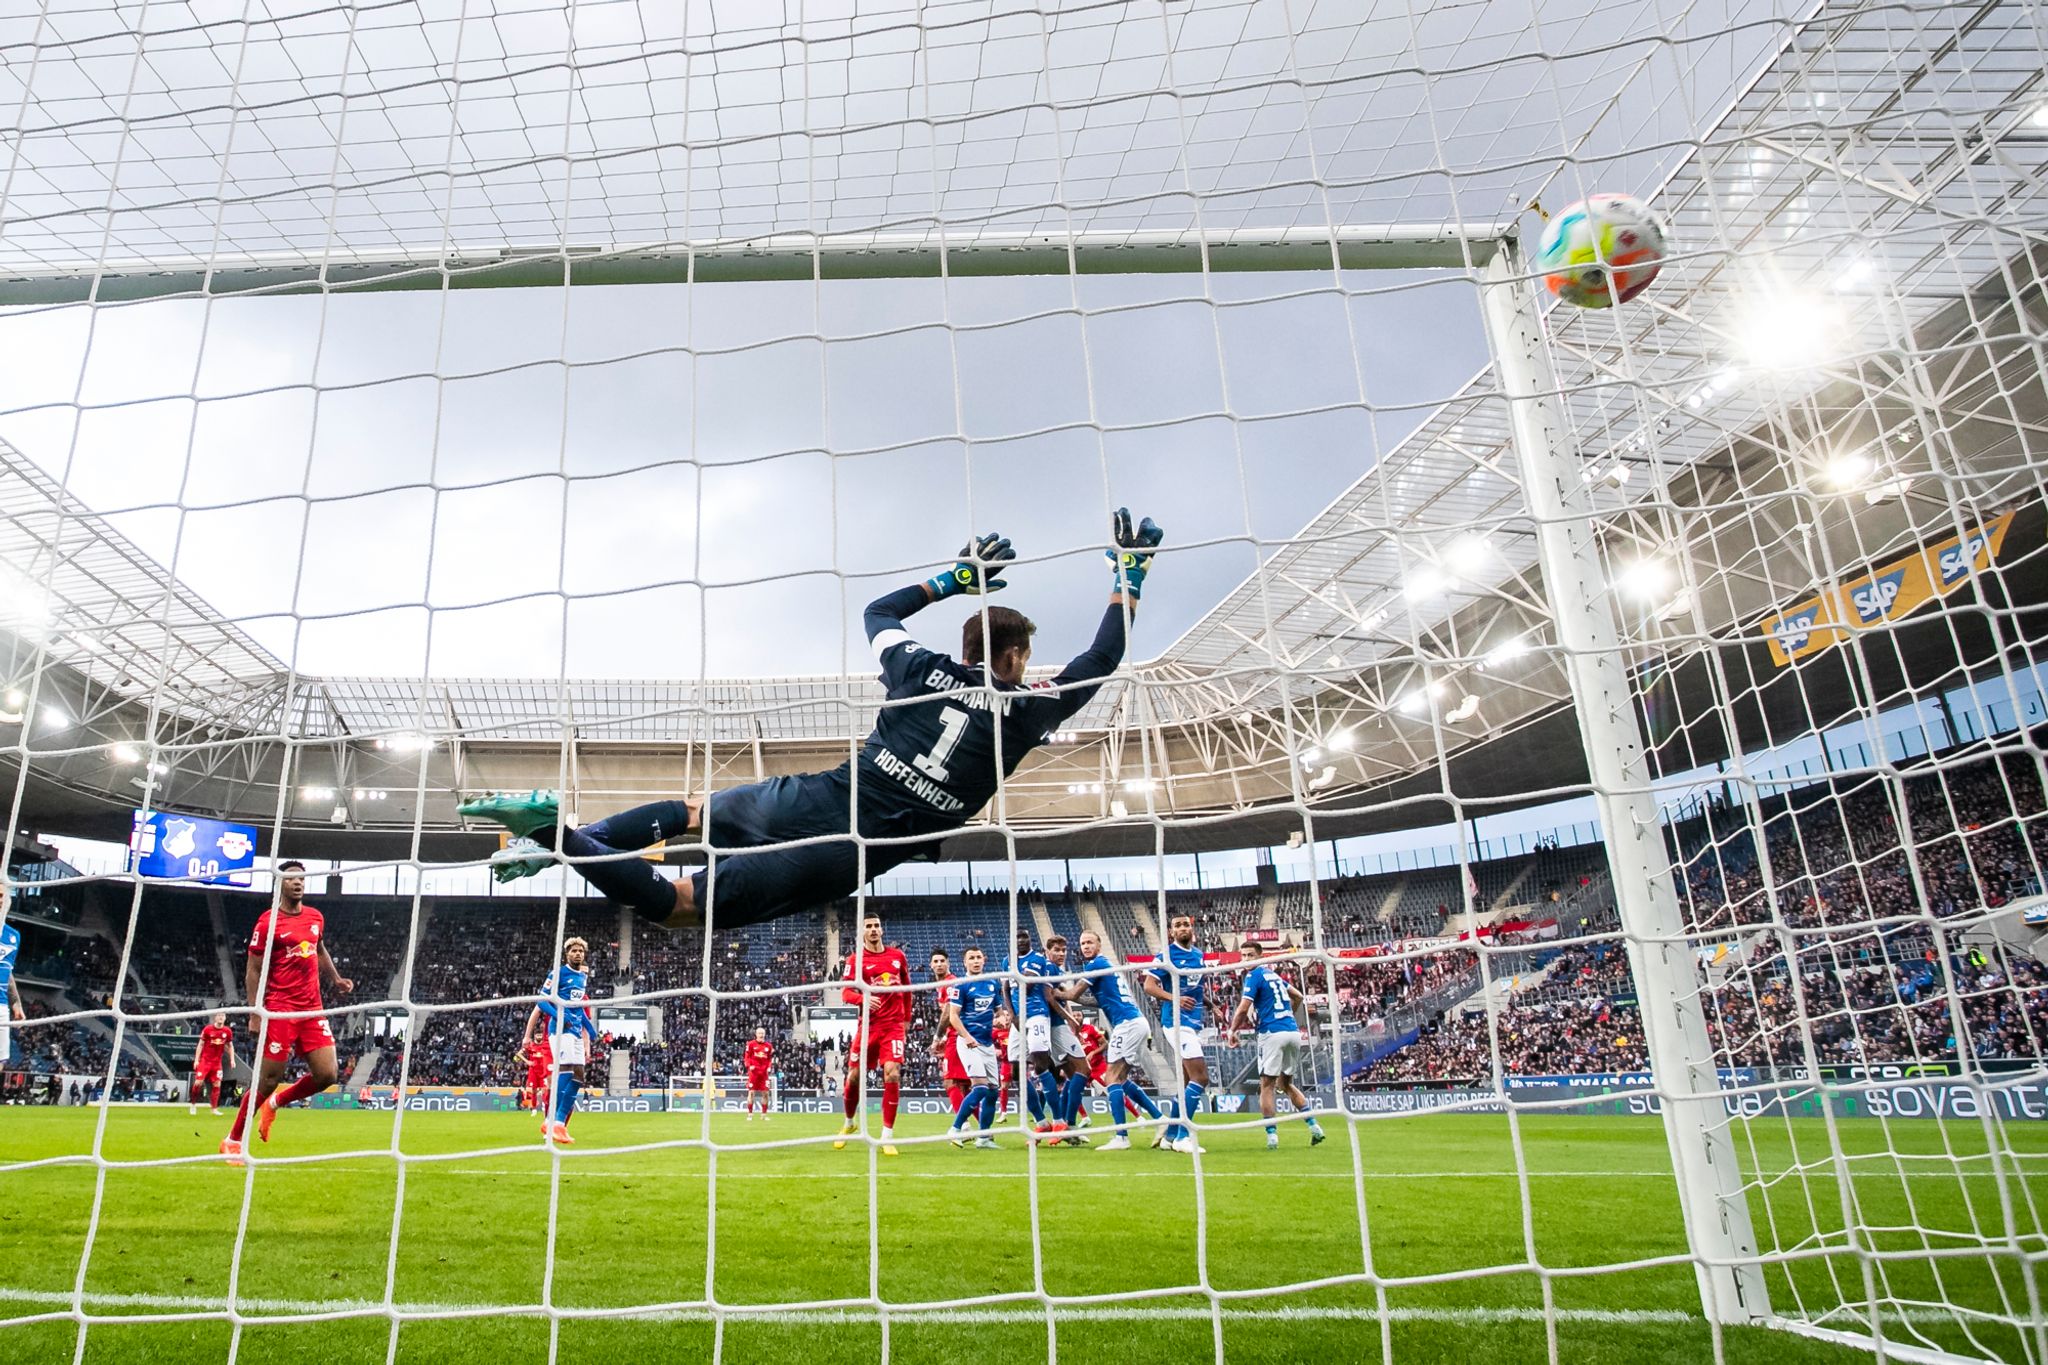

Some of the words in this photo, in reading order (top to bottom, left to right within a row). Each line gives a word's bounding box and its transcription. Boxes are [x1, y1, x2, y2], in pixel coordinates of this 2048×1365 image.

[1853, 580, 1898, 617] SAP
[912, 705, 970, 783] 1
[873, 748, 965, 811] HOFFENHEIM
[975, 1000, 990, 1009] SAP
[1033, 1024, 1046, 1037] 34
[1111, 1036, 1123, 1048] 22
[1216, 1095, 1241, 1113] SAP
[1350, 1094, 1397, 1111] EXPERIENCE
[1398, 1094, 1414, 1111] SAP
[1416, 1093, 1435, 1110] LIKE
[1865, 1086, 2048, 1118] sovant
